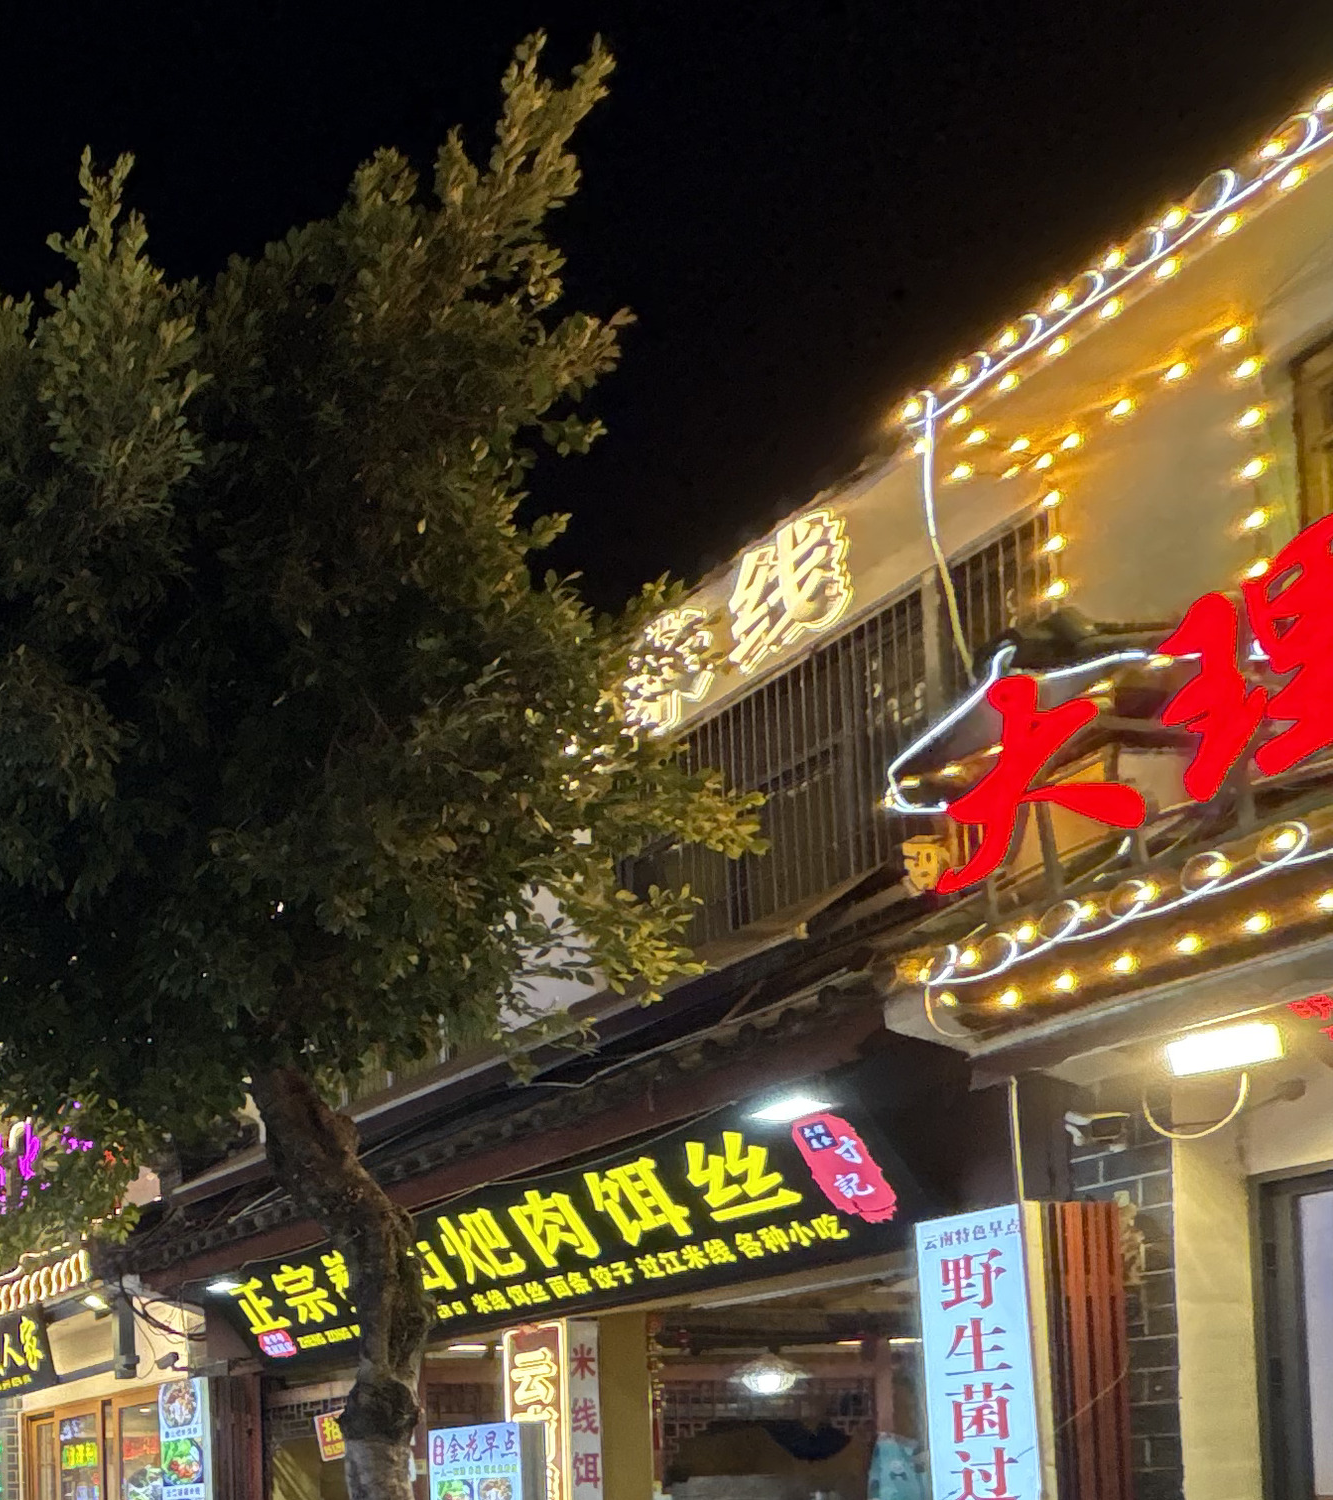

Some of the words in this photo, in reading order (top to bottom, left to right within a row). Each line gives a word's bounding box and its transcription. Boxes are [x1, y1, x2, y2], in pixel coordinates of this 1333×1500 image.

[923, 1217, 1022, 1250] 云南特色早点
[471, 1289, 512, 1314] 米线
[506, 1281, 551, 1306] 饵丝
[545, 1272, 593, 1299] 面条
[589, 1261, 634, 1290] 饺子
[635, 1238, 738, 1279] 过江米线
[735, 1213, 850, 1260] 各种小吃
[445, 1429, 519, 1464] 金花早点
